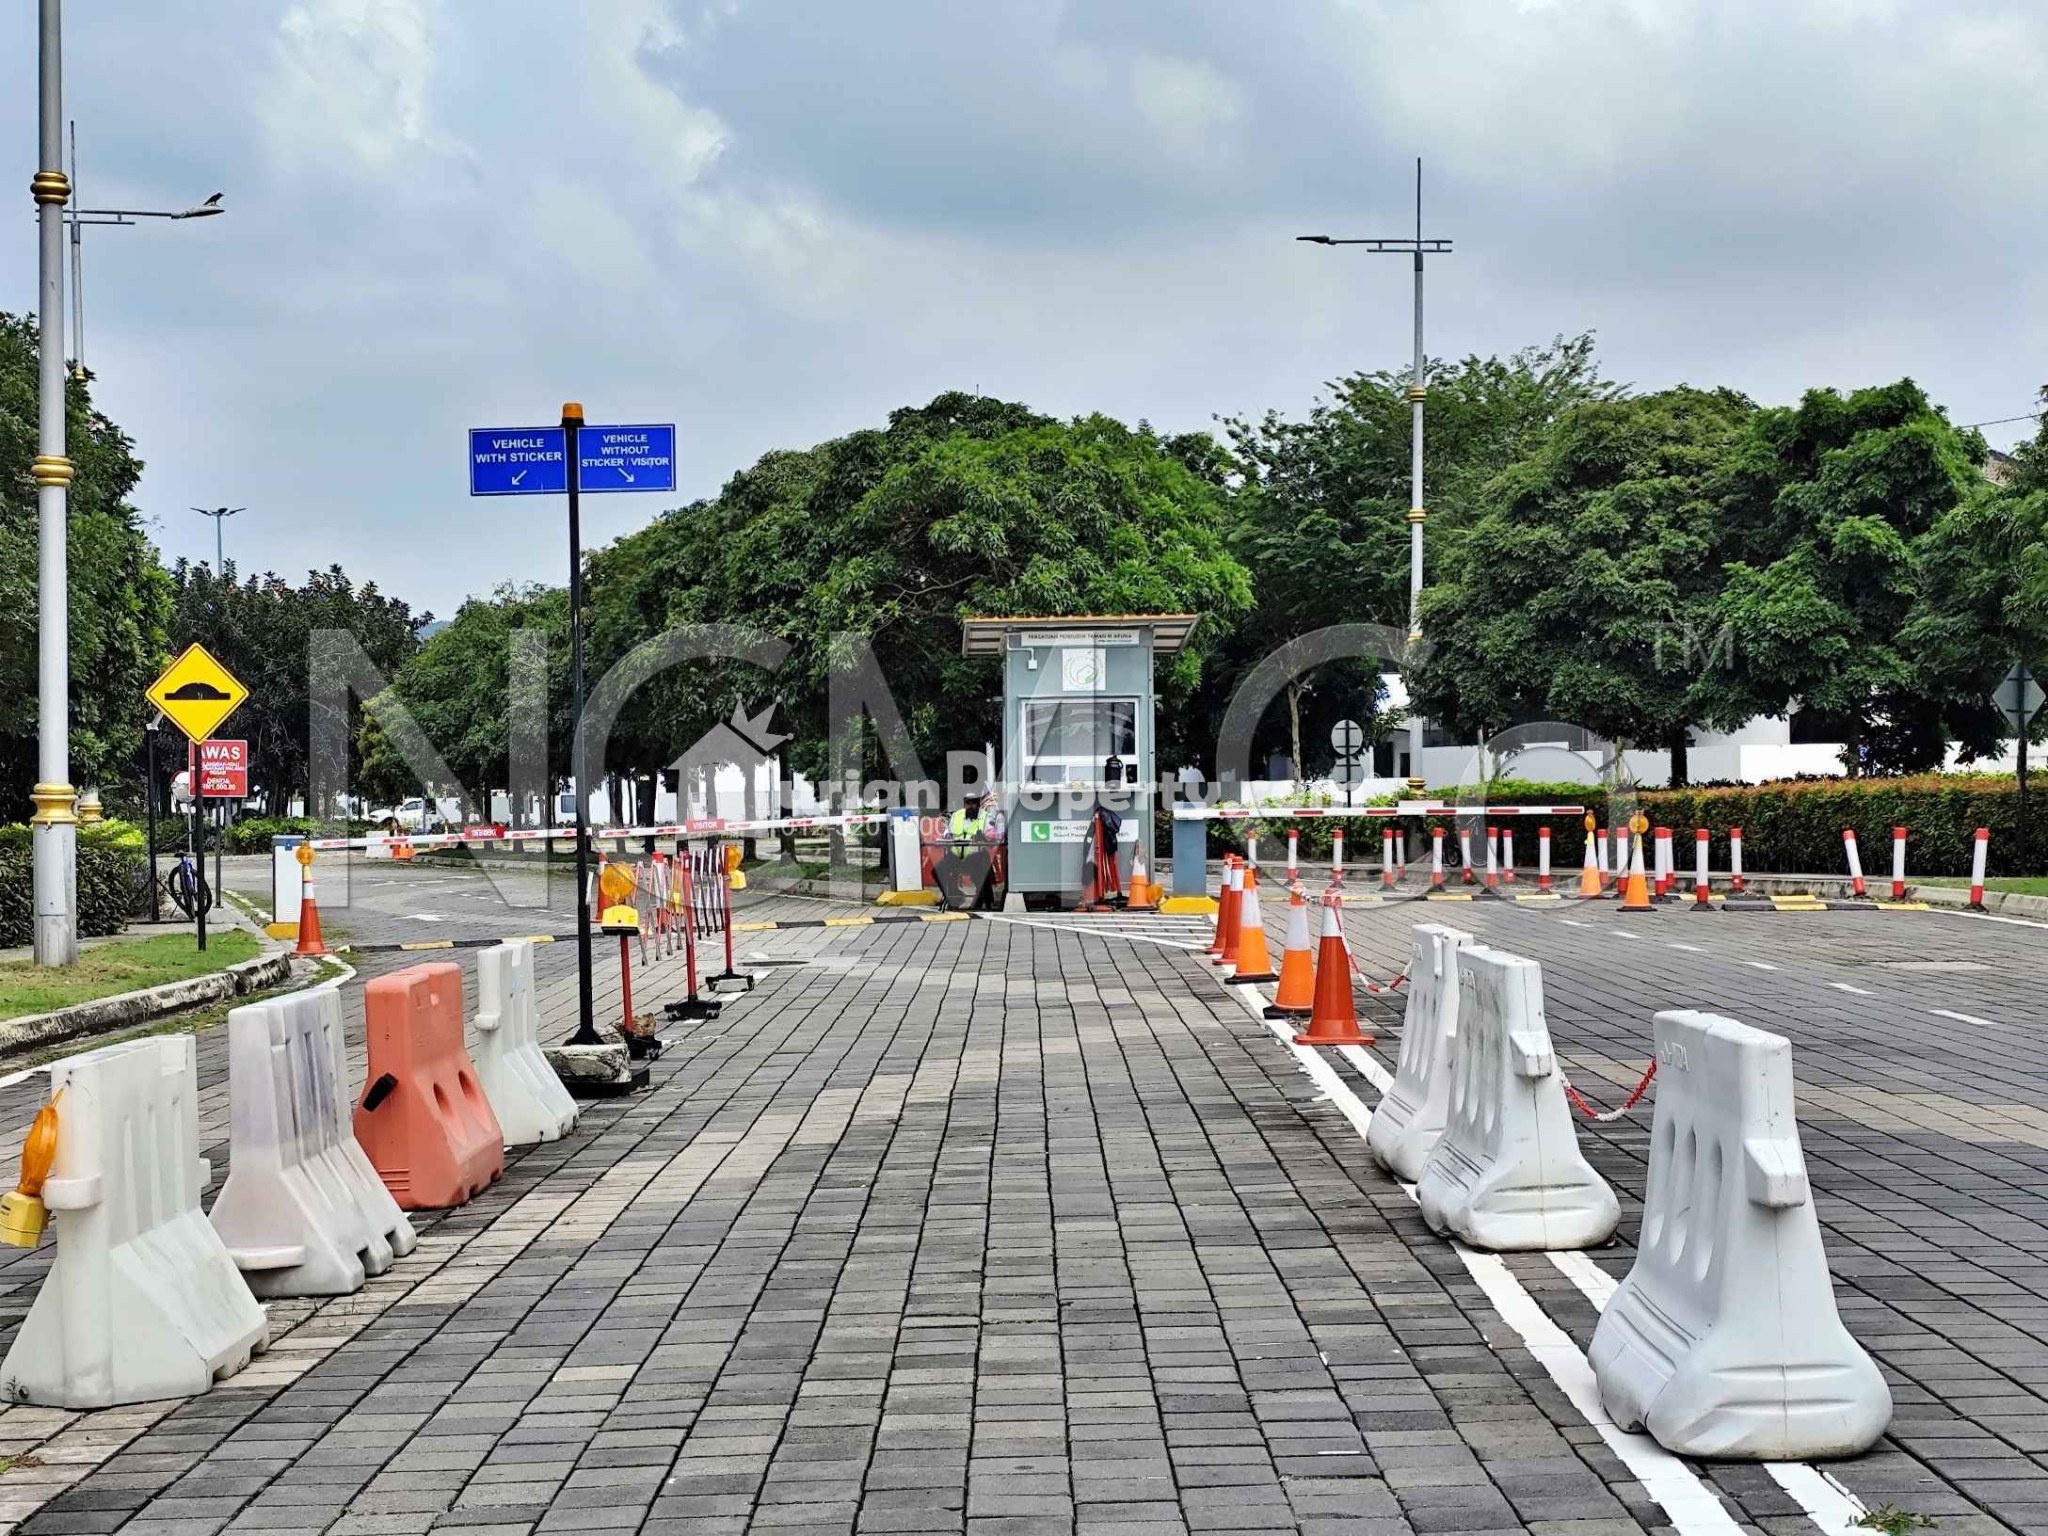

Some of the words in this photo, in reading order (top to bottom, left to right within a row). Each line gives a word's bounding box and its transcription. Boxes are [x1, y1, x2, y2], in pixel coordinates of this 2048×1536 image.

[492, 438, 545, 449] VEHICLE
[603, 434, 648, 444] VEHICLE
[601, 445, 650, 455] WITHOUT
[475, 453, 506, 464] WITH
[509, 452, 562, 462] STICKER
[581, 458, 624, 467] STICKER
[631, 457, 670, 467] VISITOR
